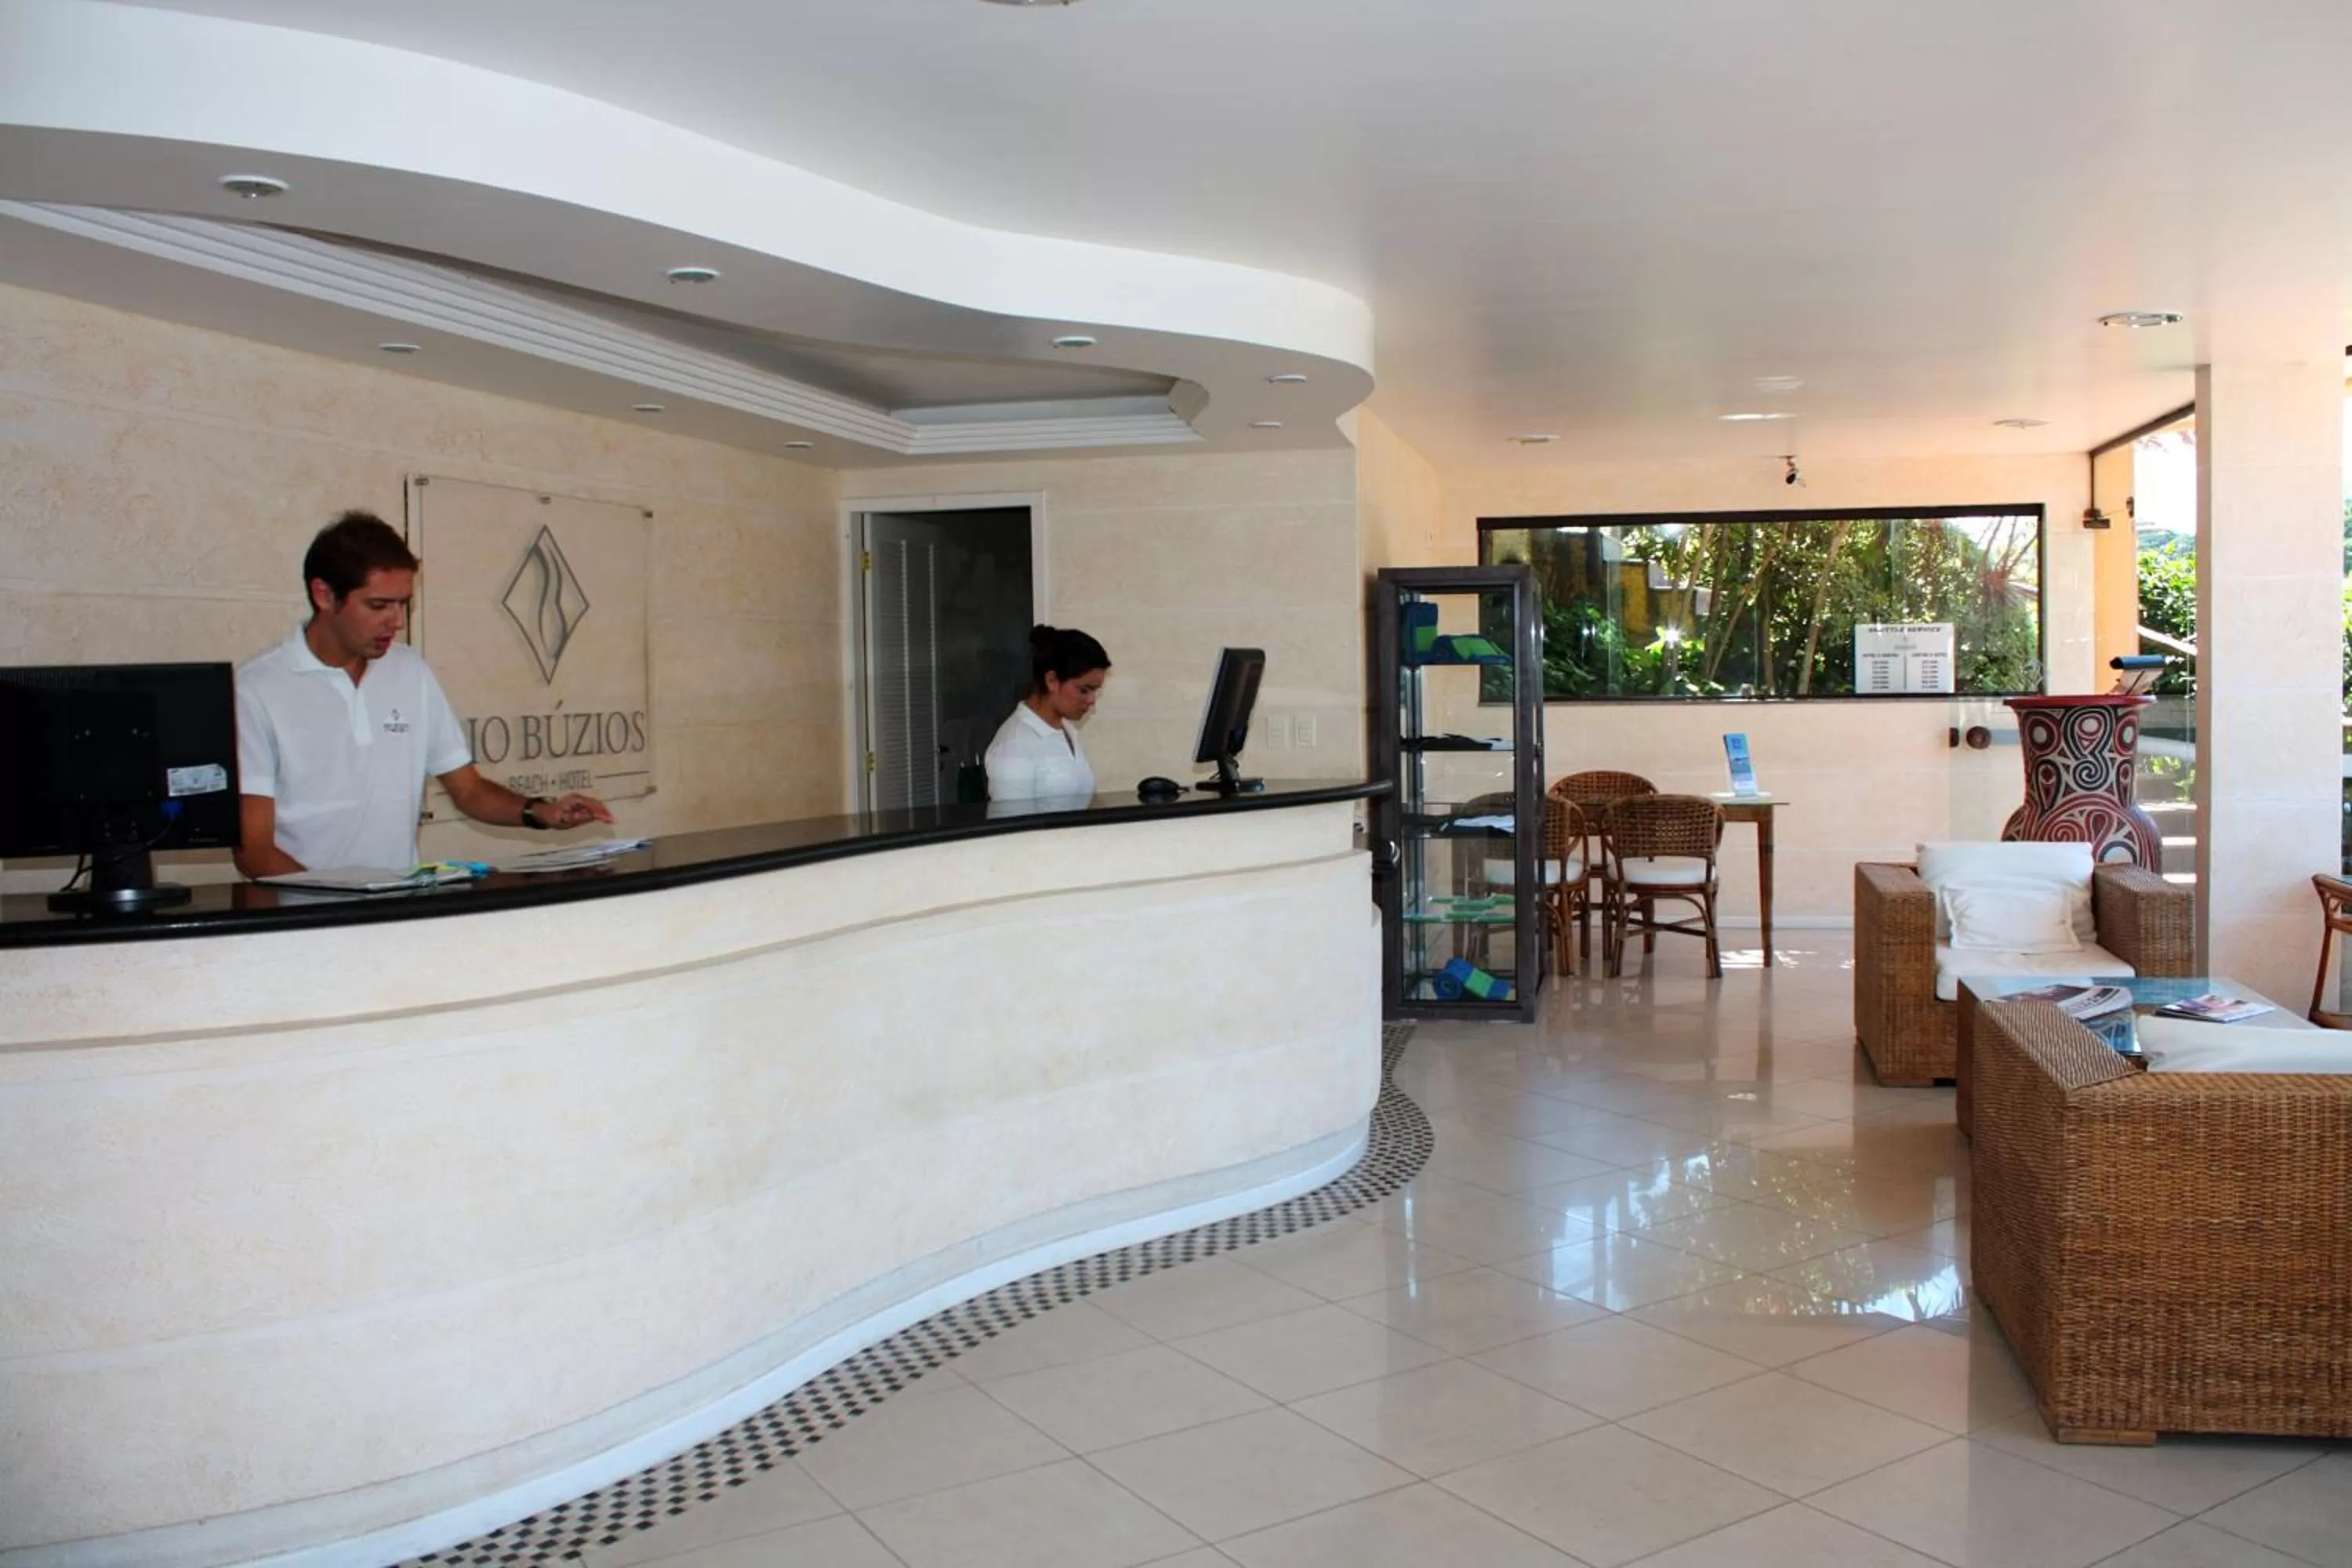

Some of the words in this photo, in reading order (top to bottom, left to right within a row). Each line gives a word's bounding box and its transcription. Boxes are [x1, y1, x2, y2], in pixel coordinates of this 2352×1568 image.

[466, 716, 511, 764] IO
[519, 699, 646, 760] BÚZIOS
[559, 770, 593, 789] HOTEL
